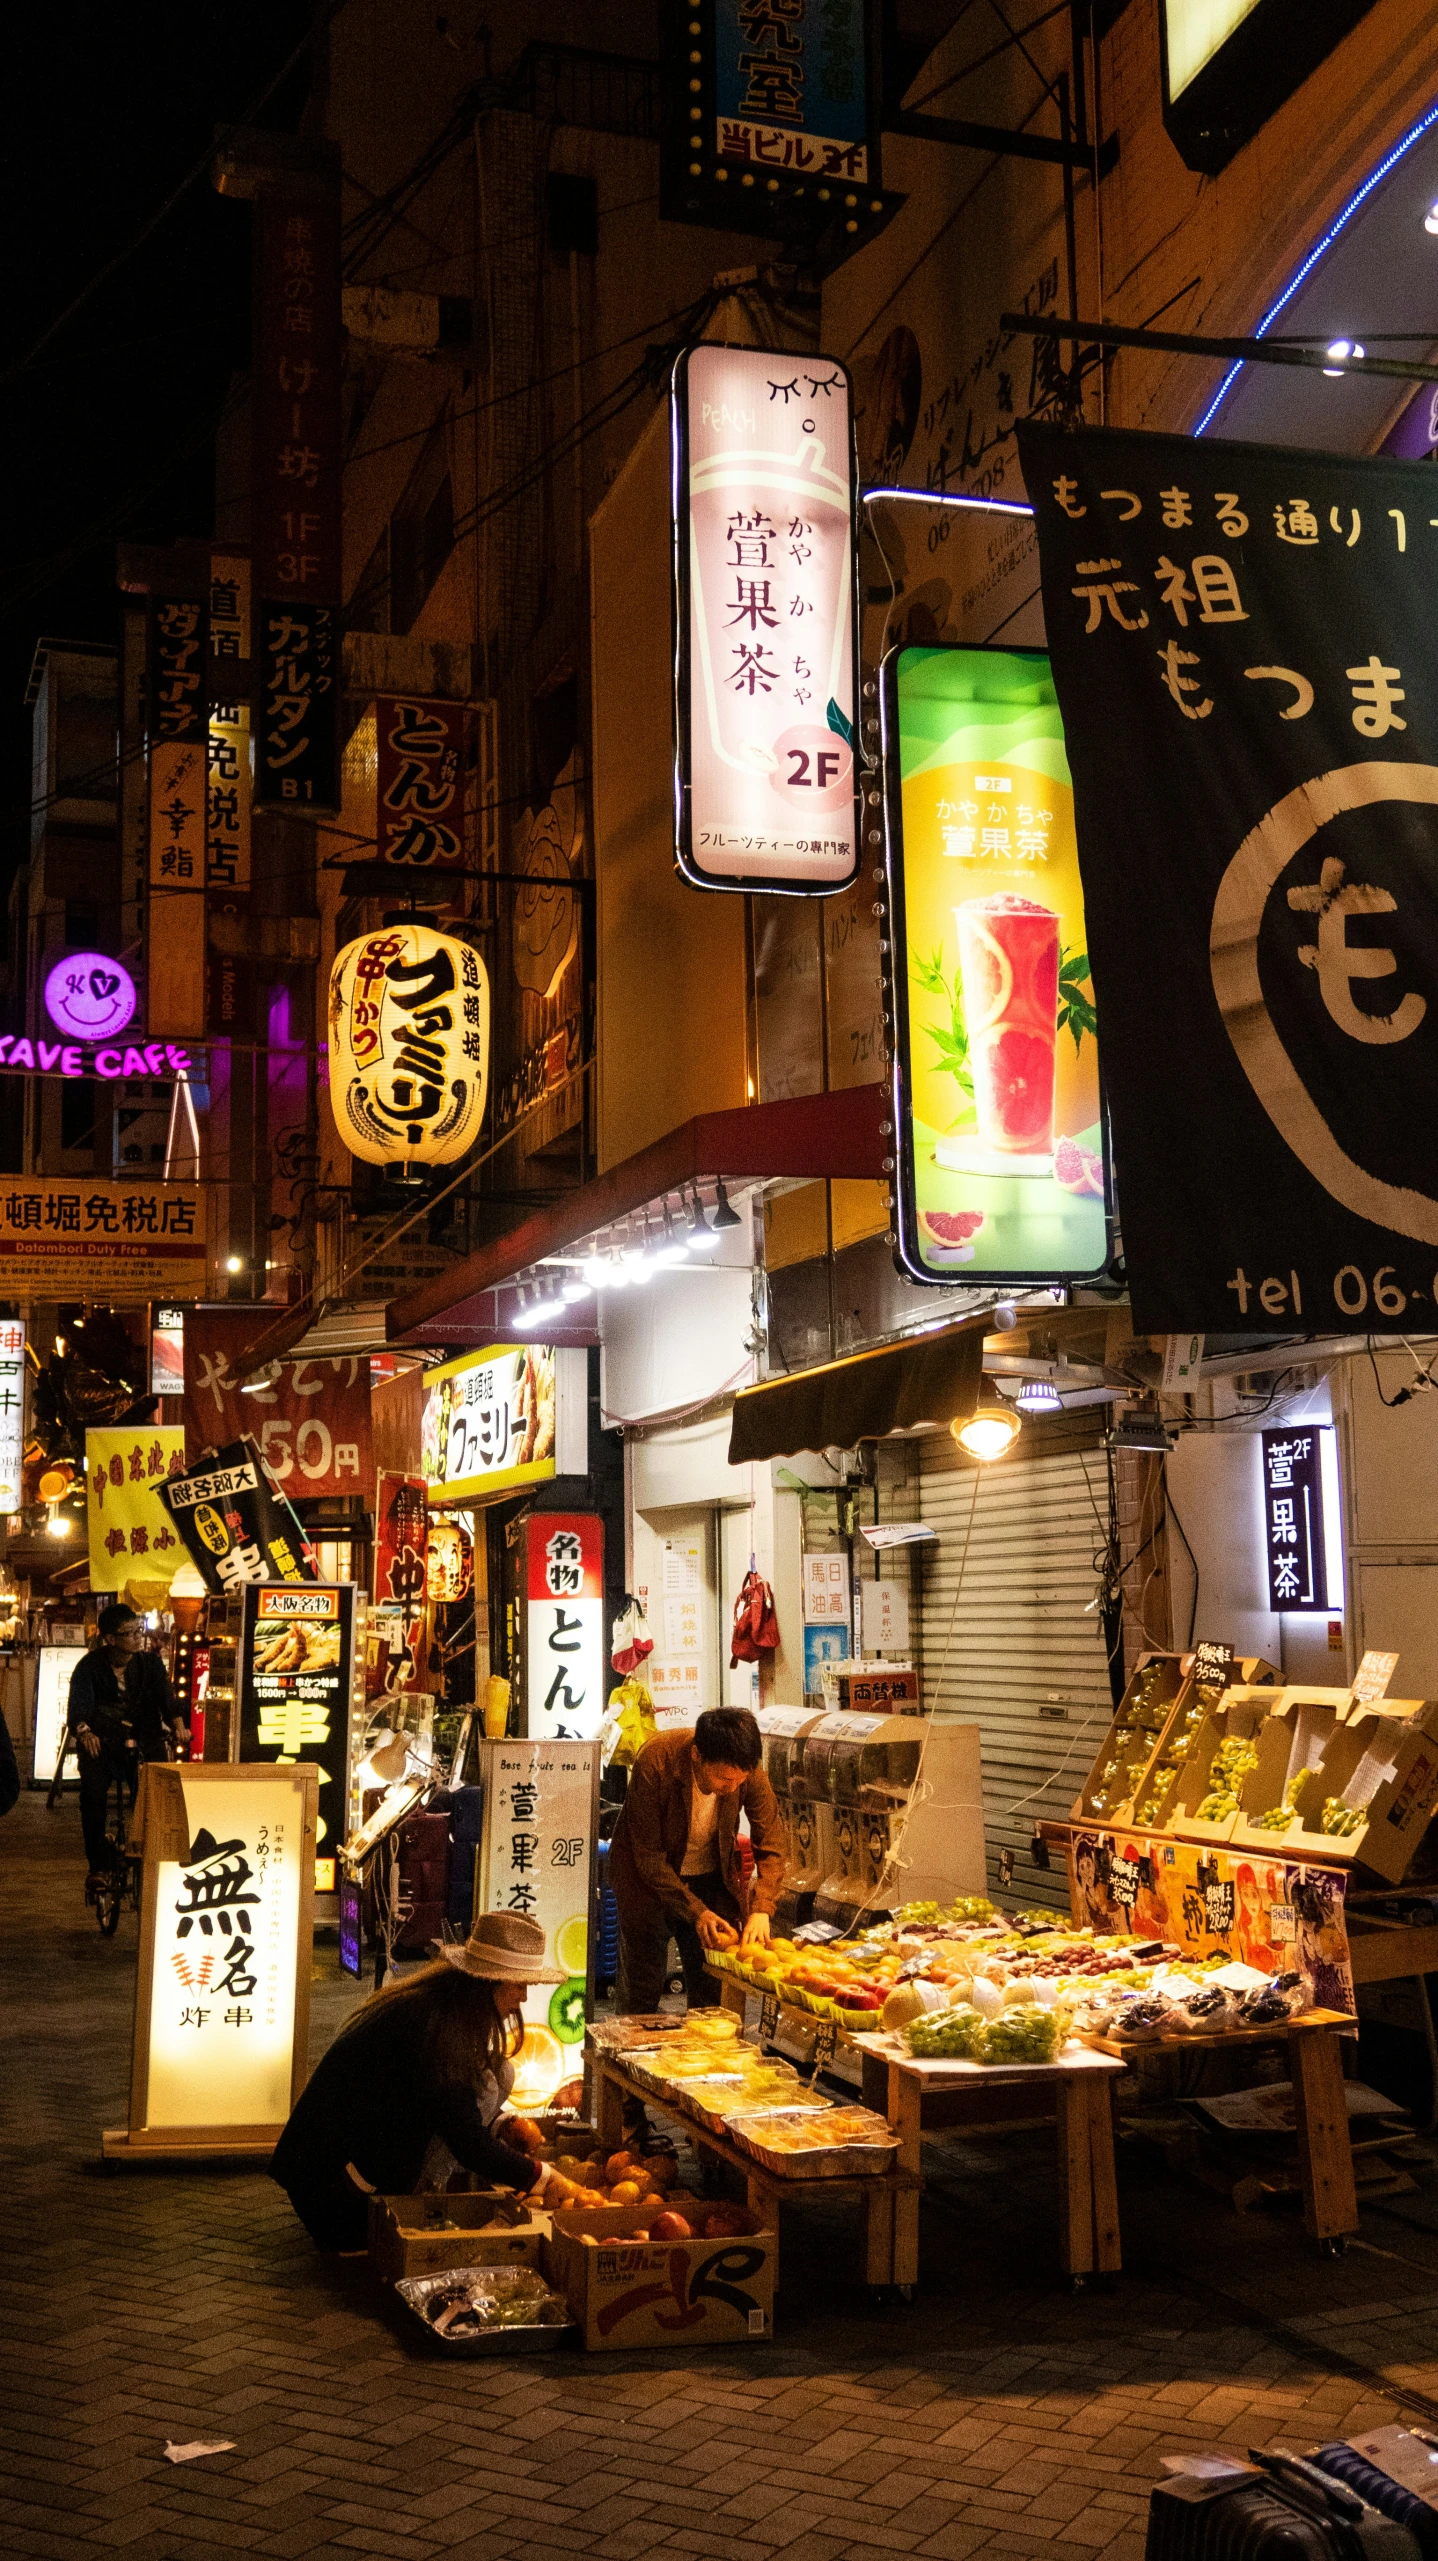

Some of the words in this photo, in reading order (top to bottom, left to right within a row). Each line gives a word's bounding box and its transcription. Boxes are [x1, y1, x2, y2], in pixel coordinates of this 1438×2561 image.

[721, 122, 814, 169] 当ビル
[701, 402, 757, 435] PEACH
[280, 511, 320, 541] 1F
[1053, 475, 1438, 552] もつまる通り1
[277, 553, 320, 582] 3F
[721, 510, 782, 696] 萱果茶
[1071, 554, 1251, 634] 元祖
[267, 615, 311, 768] カルダン
[1156, 640, 1408, 738] もつま
[281, 777, 314, 800] B1
[382, 702, 461, 865] とんか
[786, 748, 840, 788] 2F
[158, 797, 197, 878] 幸鮨
[1287, 857, 1427, 1045] も
[373, 946, 458, 1145] ファミリー
[0, 1192, 197, 1236] 頓堀免税店
[1227, 1266, 1302, 1316] tel
[453, 1401, 528, 1474] ファミリー
[1293, 1439, 1312, 1461] 2F
[1267, 1441, 1300, 1599] 萱果茶
[547, 1532, 583, 1594] 名物
[266, 1595, 331, 1613] 大阪名物
[853, 1680, 909, 1702] 両替機
[1194, 1661, 1227, 1684] 3500円
[500, 1759, 521, 1771] Best
[561, 1762, 577, 1771] tea
[550, 1837, 585, 1868] 2F
[175, 1827, 262, 1998] 無名
[178, 2004, 254, 2029] 炸串
